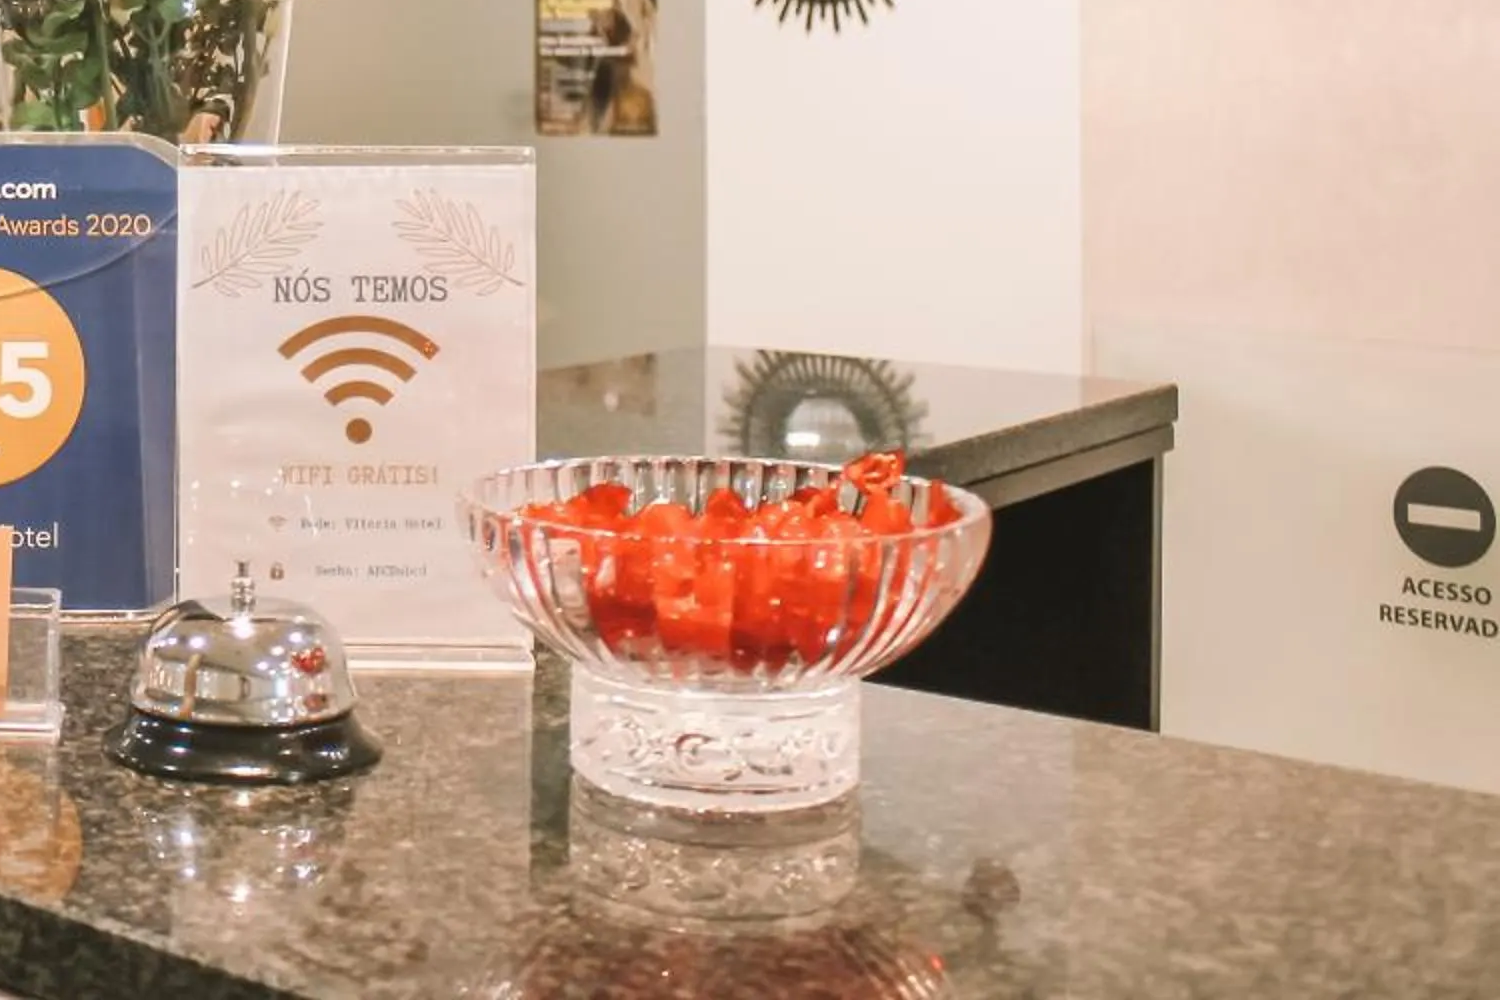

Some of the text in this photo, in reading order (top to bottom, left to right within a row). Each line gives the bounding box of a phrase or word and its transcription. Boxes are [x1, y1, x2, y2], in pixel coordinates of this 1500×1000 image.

[86, 214, 152, 237] 2020
[274, 267, 448, 303] NÓS TEMOS
[282, 464, 333, 485] WIFI
[7, 521, 59, 548] otel
[1402, 576, 1492, 606] ACESSO
[1379, 603, 1499, 639] RESERVAD
